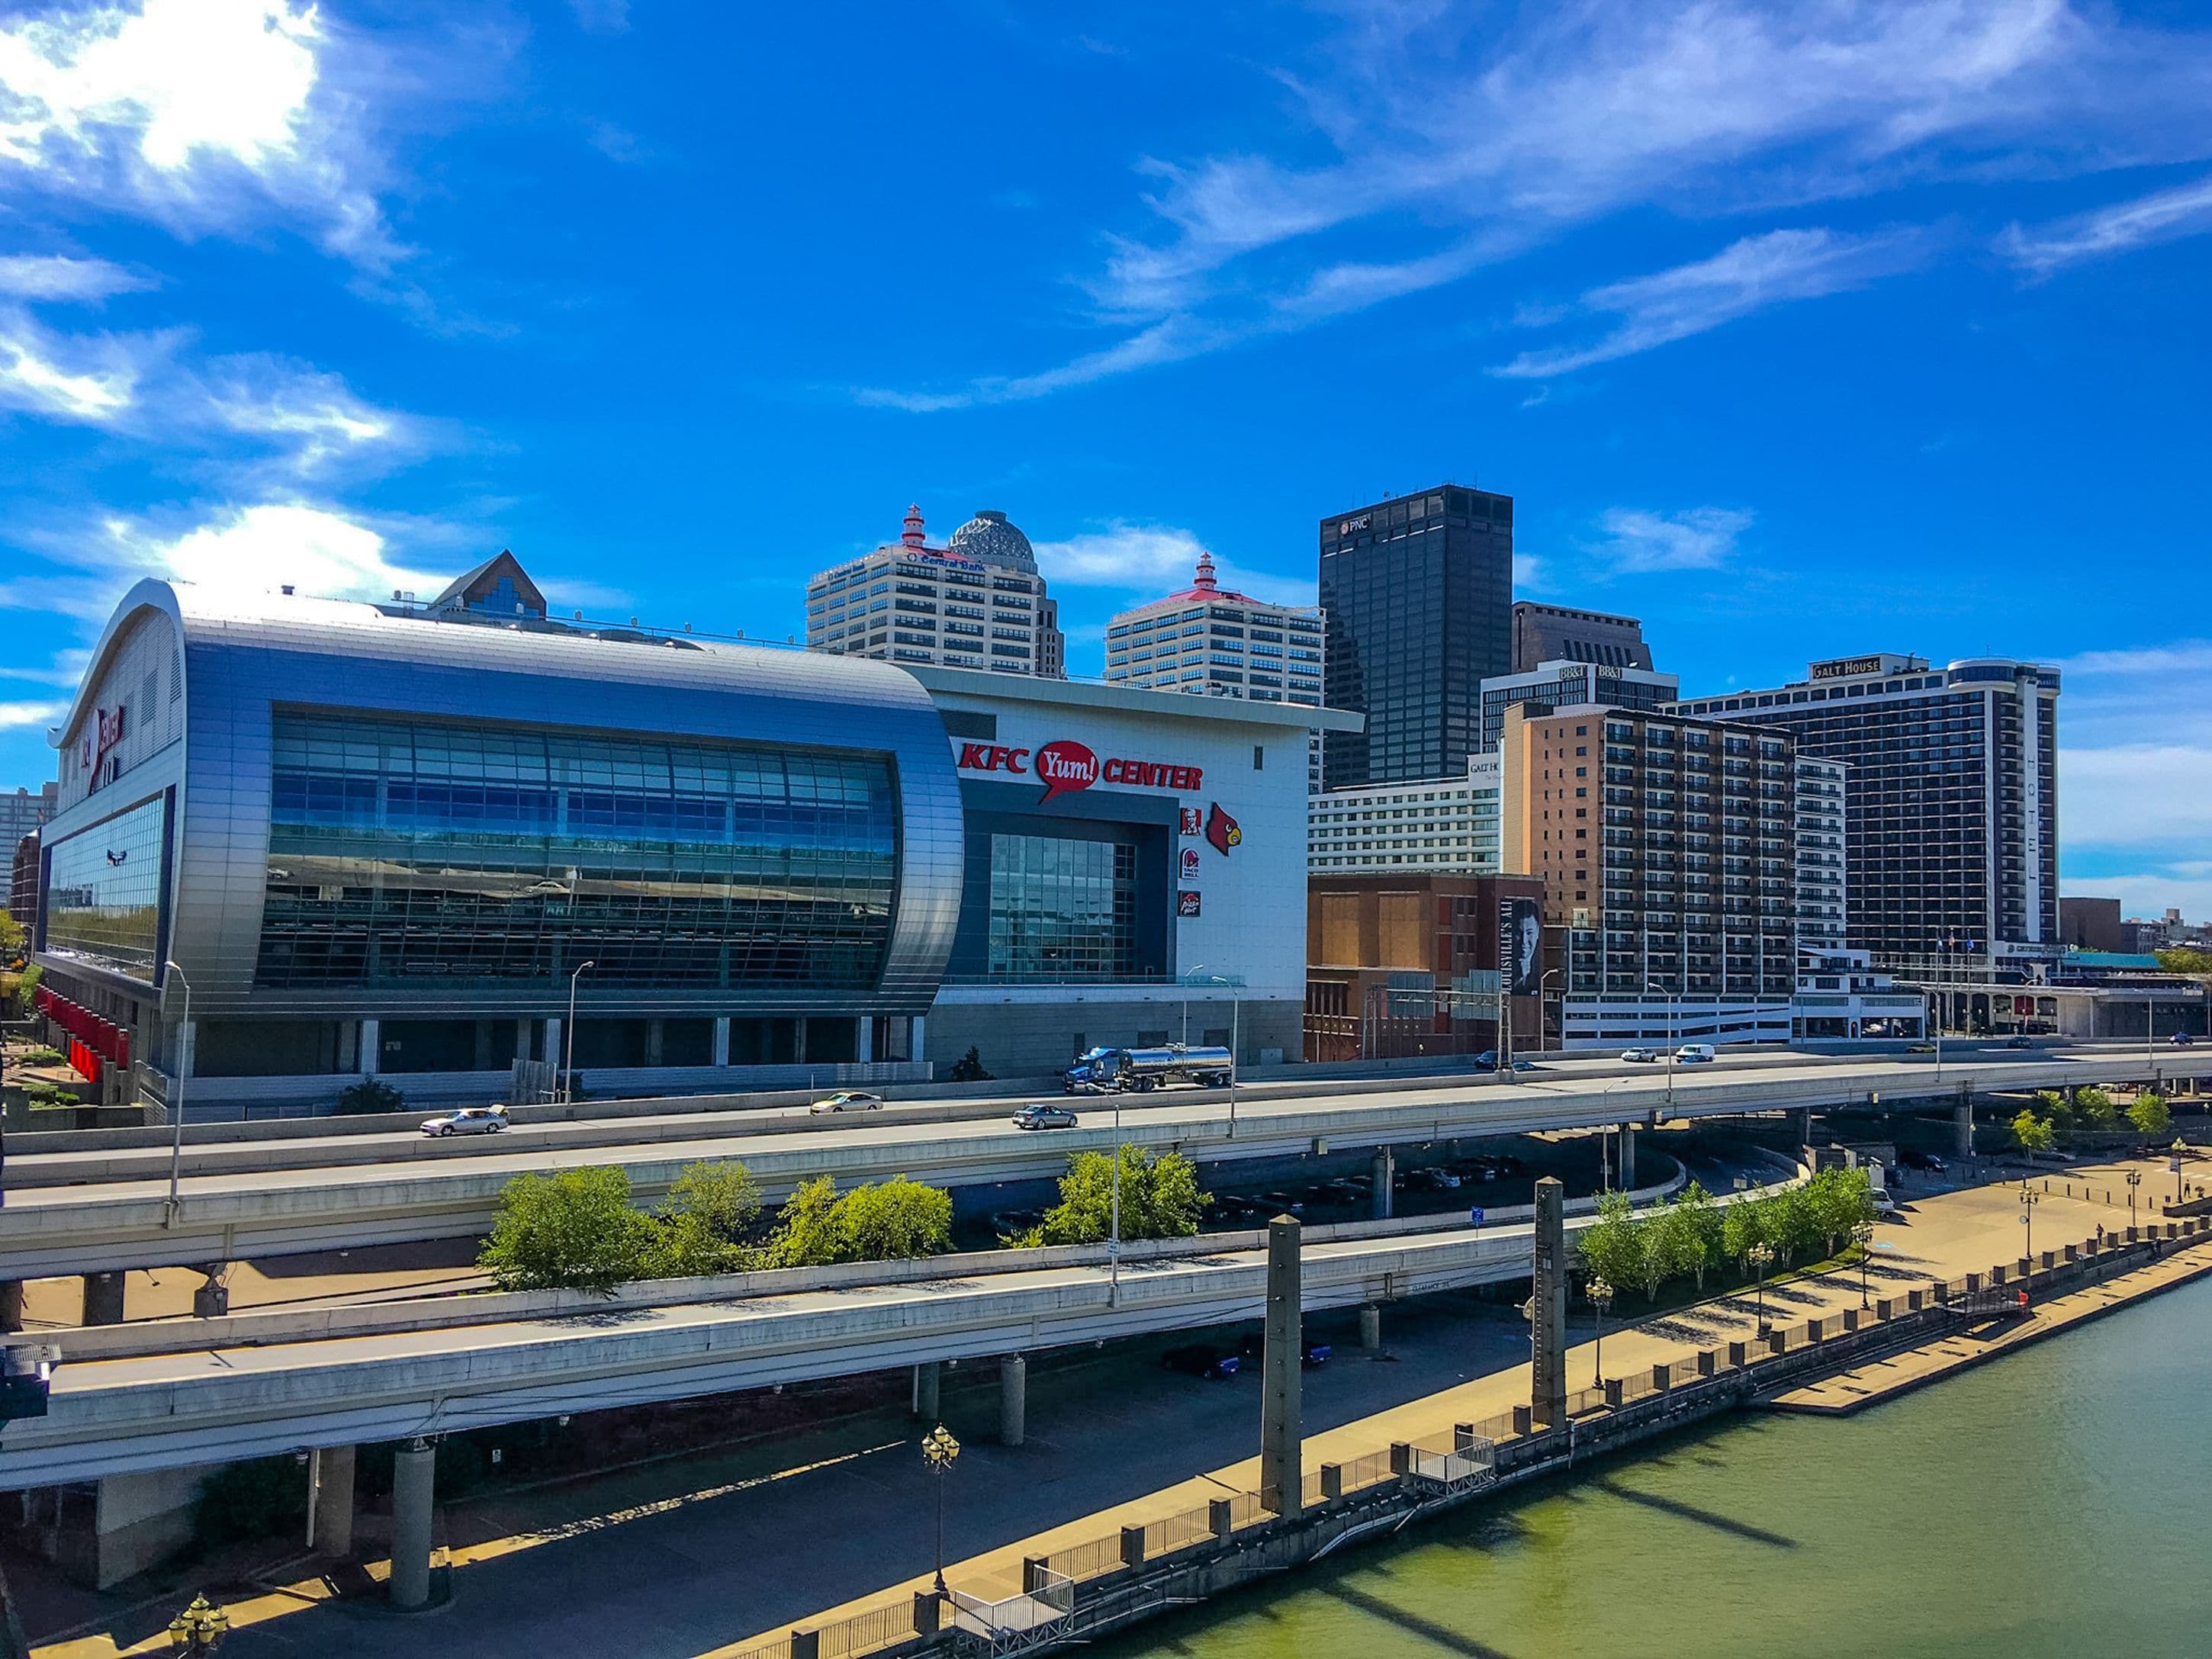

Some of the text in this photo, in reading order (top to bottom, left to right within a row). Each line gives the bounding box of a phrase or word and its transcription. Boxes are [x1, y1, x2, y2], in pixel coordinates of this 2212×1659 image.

[1349, 518, 1368, 532] PNC
[921, 555, 985, 571] Central Bank
[1561, 666, 1583, 679] BB&T
[1599, 665, 1621, 679] BB&T
[1814, 661, 1879, 678] GALT HOUSE
[959, 743, 1203, 790] KFC Yum! CENTER
[1471, 764, 1488, 773] GALT
[1500, 902, 1513, 991] LOUISVILLE'S ALI
